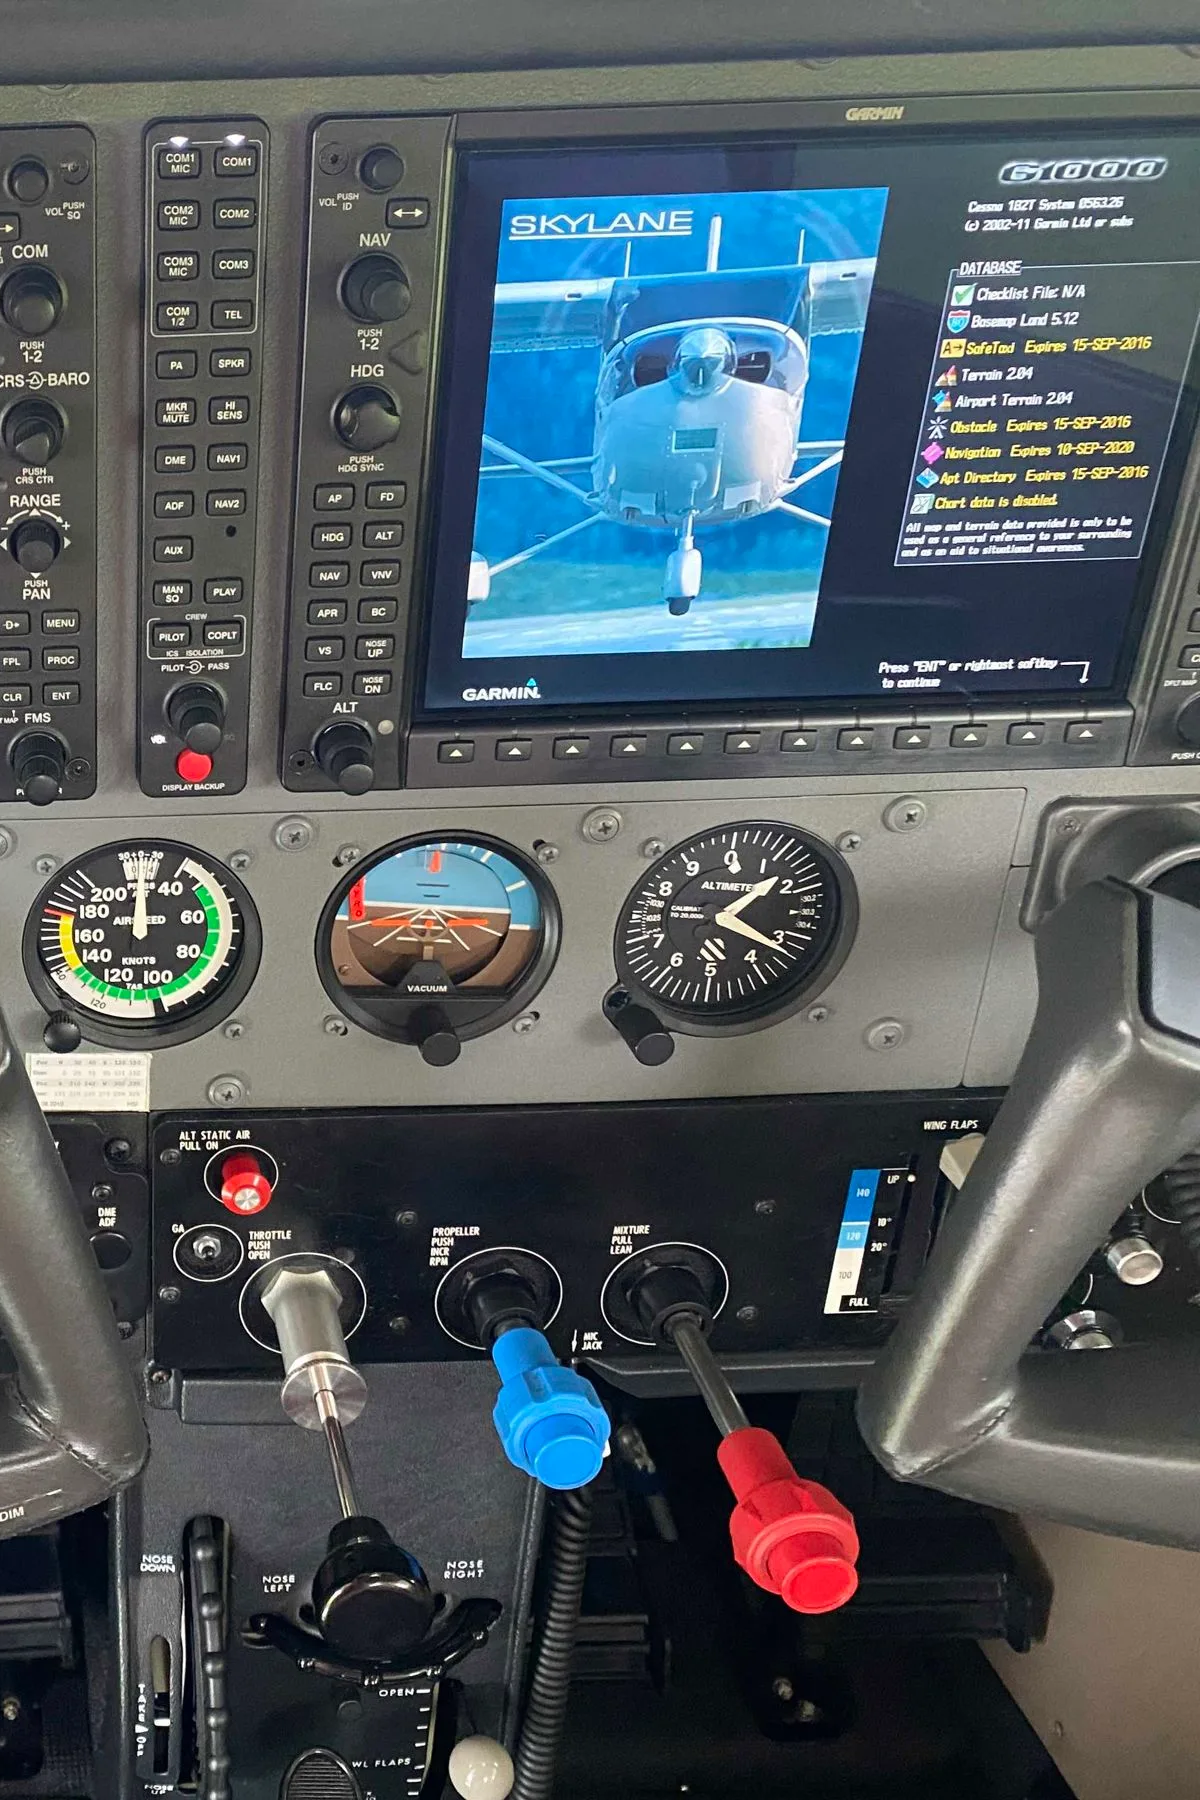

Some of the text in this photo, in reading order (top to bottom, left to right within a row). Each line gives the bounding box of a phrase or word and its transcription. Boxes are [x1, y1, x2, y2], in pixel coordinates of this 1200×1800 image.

[846, 107, 904, 121] GARMIN
[166, 154, 194, 163] COM1
[171, 164, 190, 173] MIC
[1000, 158, 1168, 184] G1000
[509, 210, 694, 236] SKYLANE
[359, 233, 390, 246] NAV
[12, 245, 48, 258] COM
[960, 261, 1022, 275] DATABASE
[977, 285, 1085, 300] Checklist N/A
[1052, 312, 1079, 325] 5.12
[1025, 336, 1152, 354] Expires 15-SEP-2016
[23, 352, 42, 362] 1-2
[218, 359, 244, 368] SPKR
[350, 365, 383, 377] HDG
[962, 370, 1002, 381] Terrain
[48, 372, 89, 385] BARO
[951, 416, 1131, 434] Obstacle 15-SEP-2016
[165, 456, 185, 465] DME
[10, 494, 60, 507] RANGE
[23, 589, 50, 600] PAN
[208, 631, 237, 640] COPLT
[462, 686, 541, 701] GARMIN
[333, 702, 358, 712] ALT
[158, 882, 183, 896] 40
[91, 888, 127, 902] 200
[122, 956, 155, 965] KNOTS
[104, 968, 133, 982] 120
[144, 970, 173, 984] 100
[407, 984, 448, 993] VACUUM
[924, 1120, 978, 1130] WING FLAPS
[179, 1129, 250, 1141] ALT STATIC AIR
[249, 1230, 291, 1241] THROTTLE
[432, 1227, 480, 1236] PROPELLER
[613, 1225, 650, 1235] MIXTURE
[849, 1298, 870, 1307] FULL
[0, 1507, 25, 1523] DIM
[140, 1563, 175, 1573] DOWN
[447, 1560, 483, 1570] NOSE
[444, 1568, 483, 1579] RIGHT
[378, 1688, 414, 1697] OPEN
[375, 1758, 411, 1768] FLAPS
